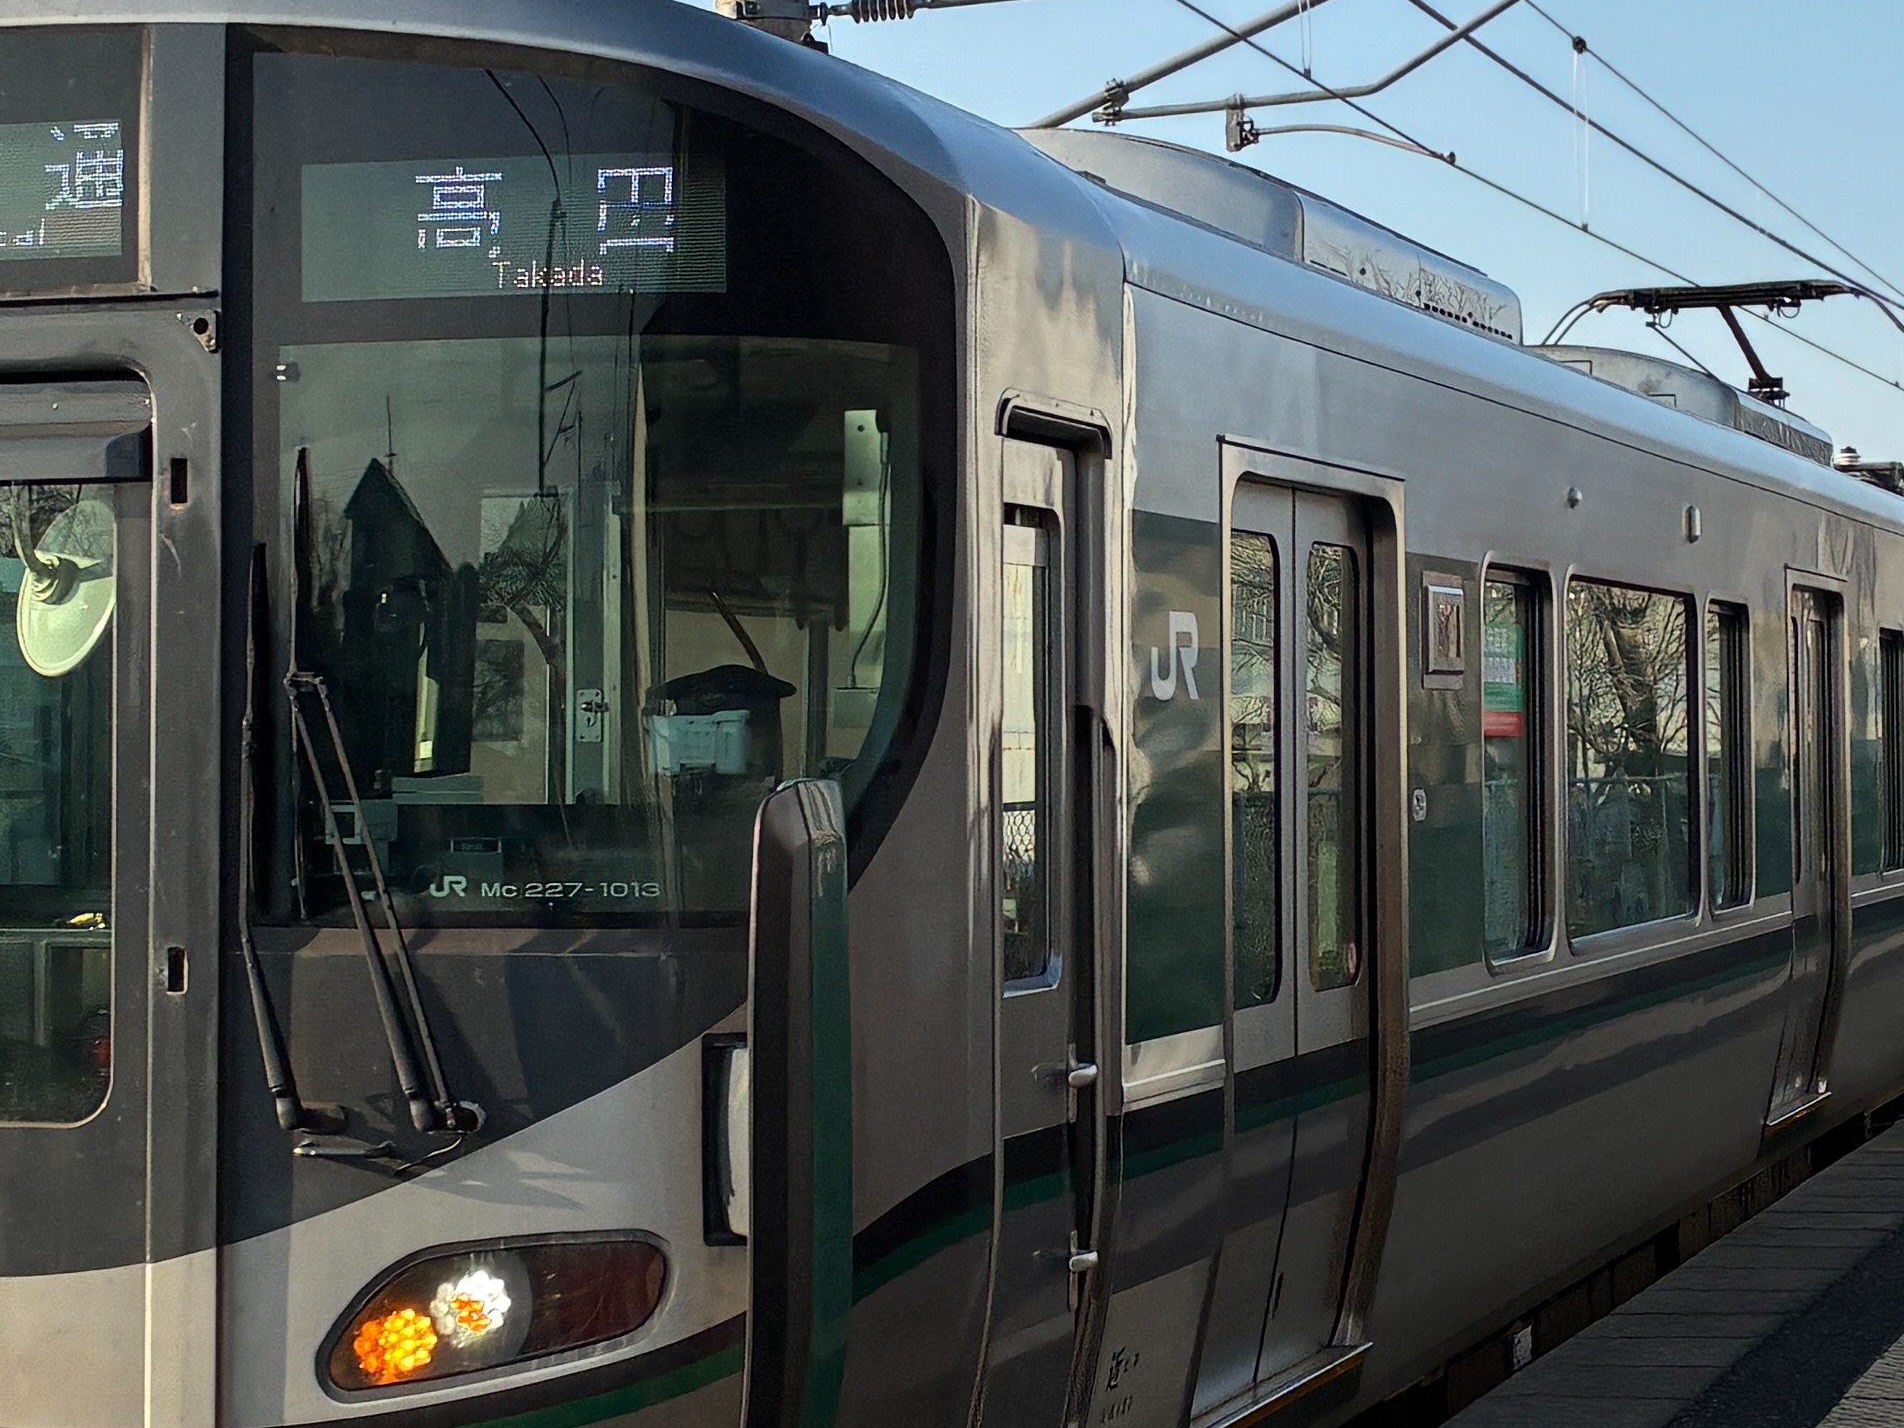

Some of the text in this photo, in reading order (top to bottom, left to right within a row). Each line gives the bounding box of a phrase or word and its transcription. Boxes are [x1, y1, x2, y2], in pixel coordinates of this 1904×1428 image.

[415, 165, 675, 259] 高田
[492, 258, 604, 290] Takada
[1150, 610, 1200, 701] JR
[429, 875, 468, 898] JR
